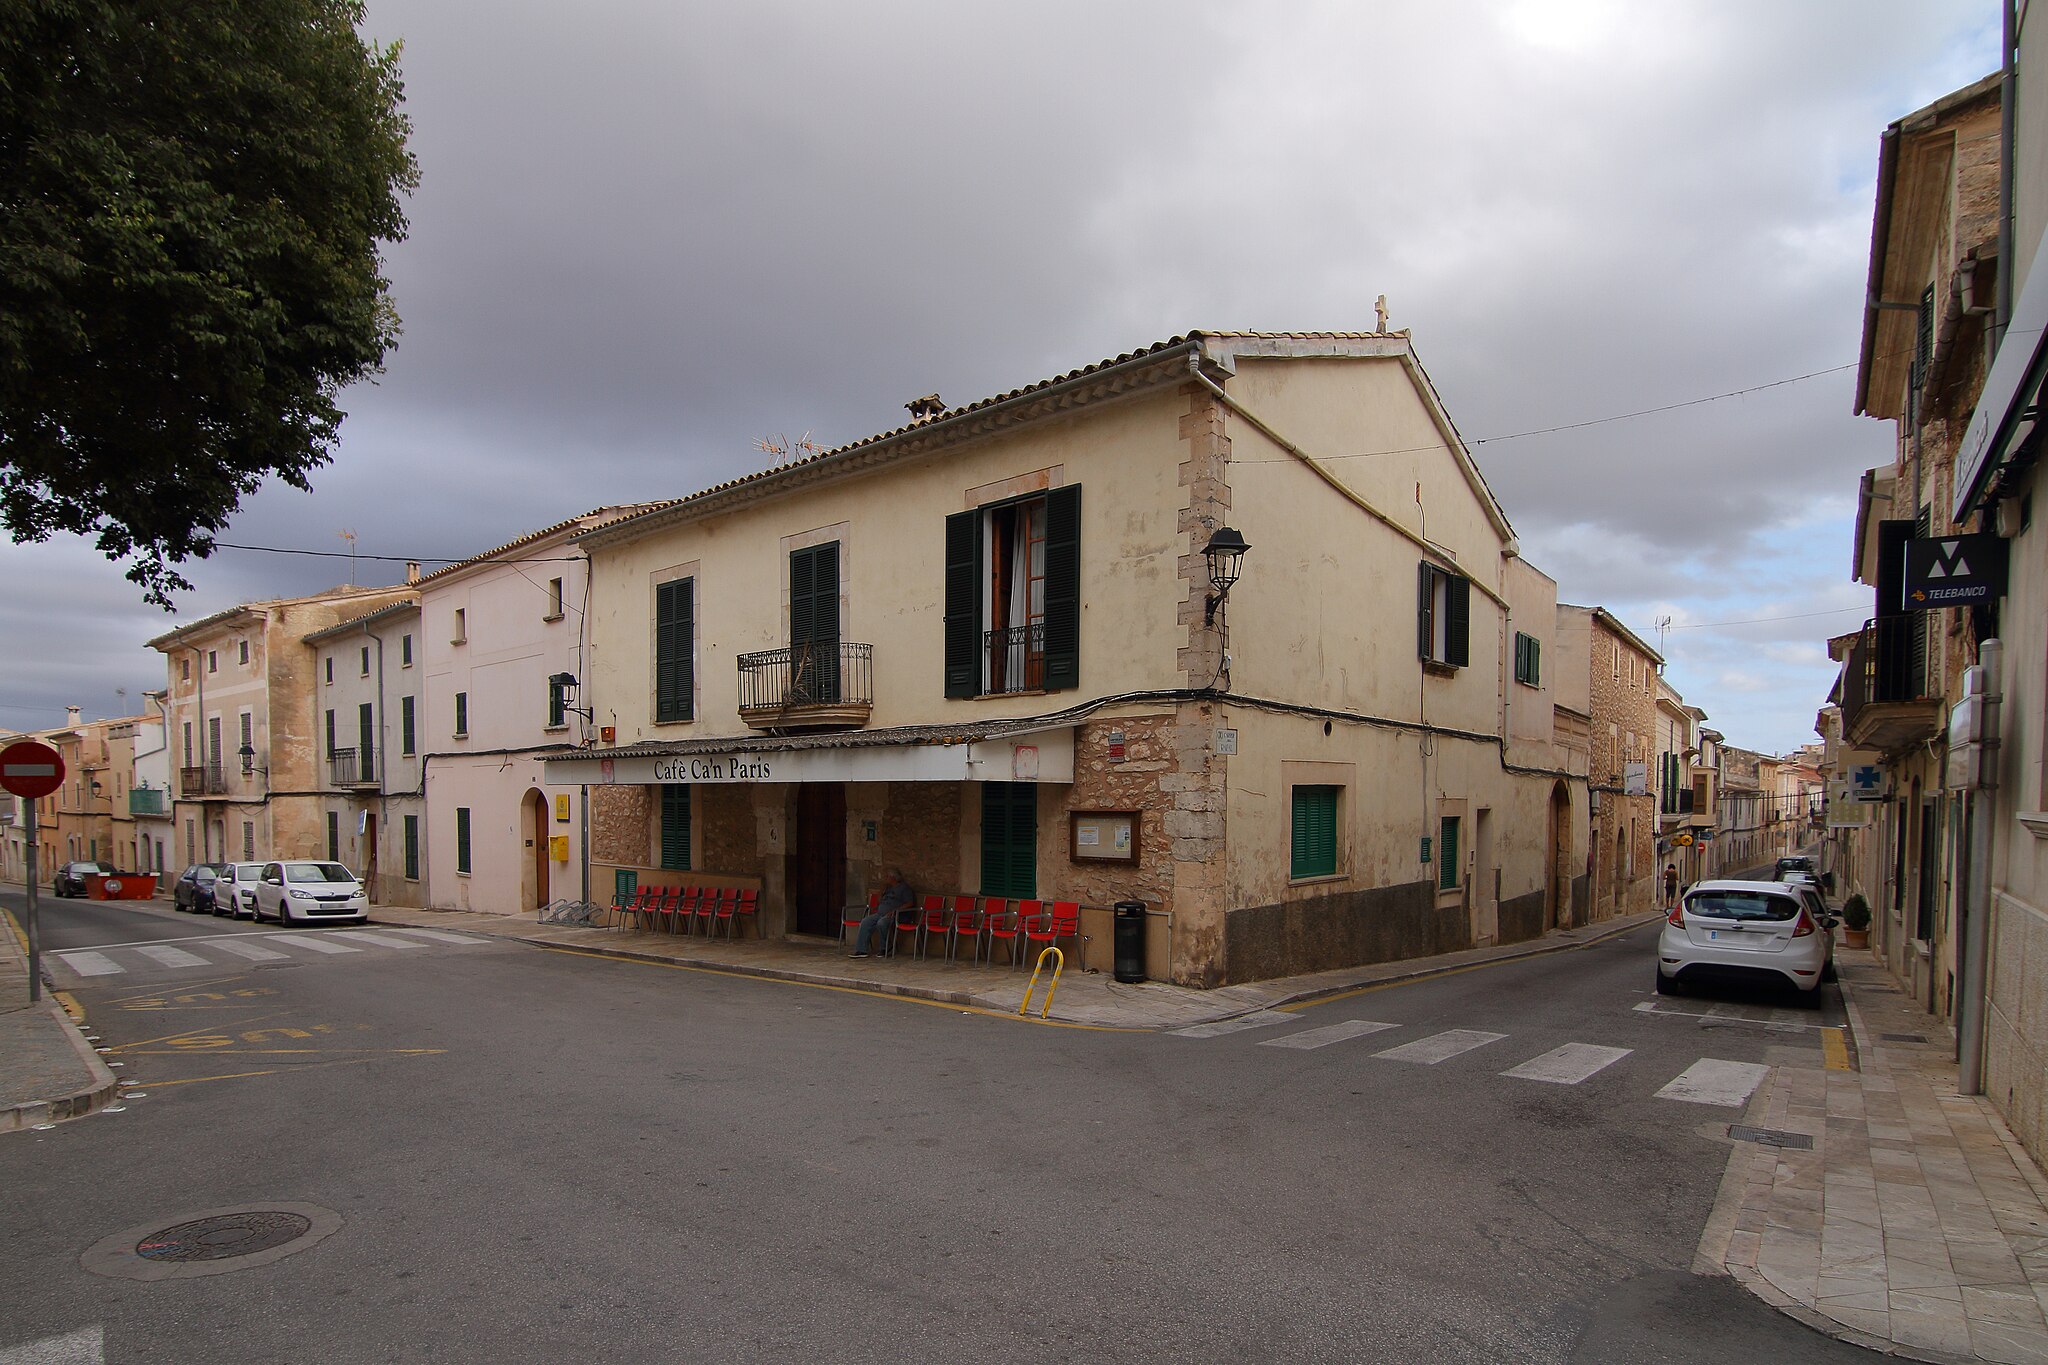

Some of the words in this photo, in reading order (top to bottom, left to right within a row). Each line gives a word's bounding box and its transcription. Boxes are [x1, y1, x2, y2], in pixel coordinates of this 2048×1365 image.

[1928, 586, 1986, 599] TELEBANCO
[654, 758, 686, 780] Cafè
[691, 757, 723, 779] Ca'n
[728, 756, 771, 778] Paris
